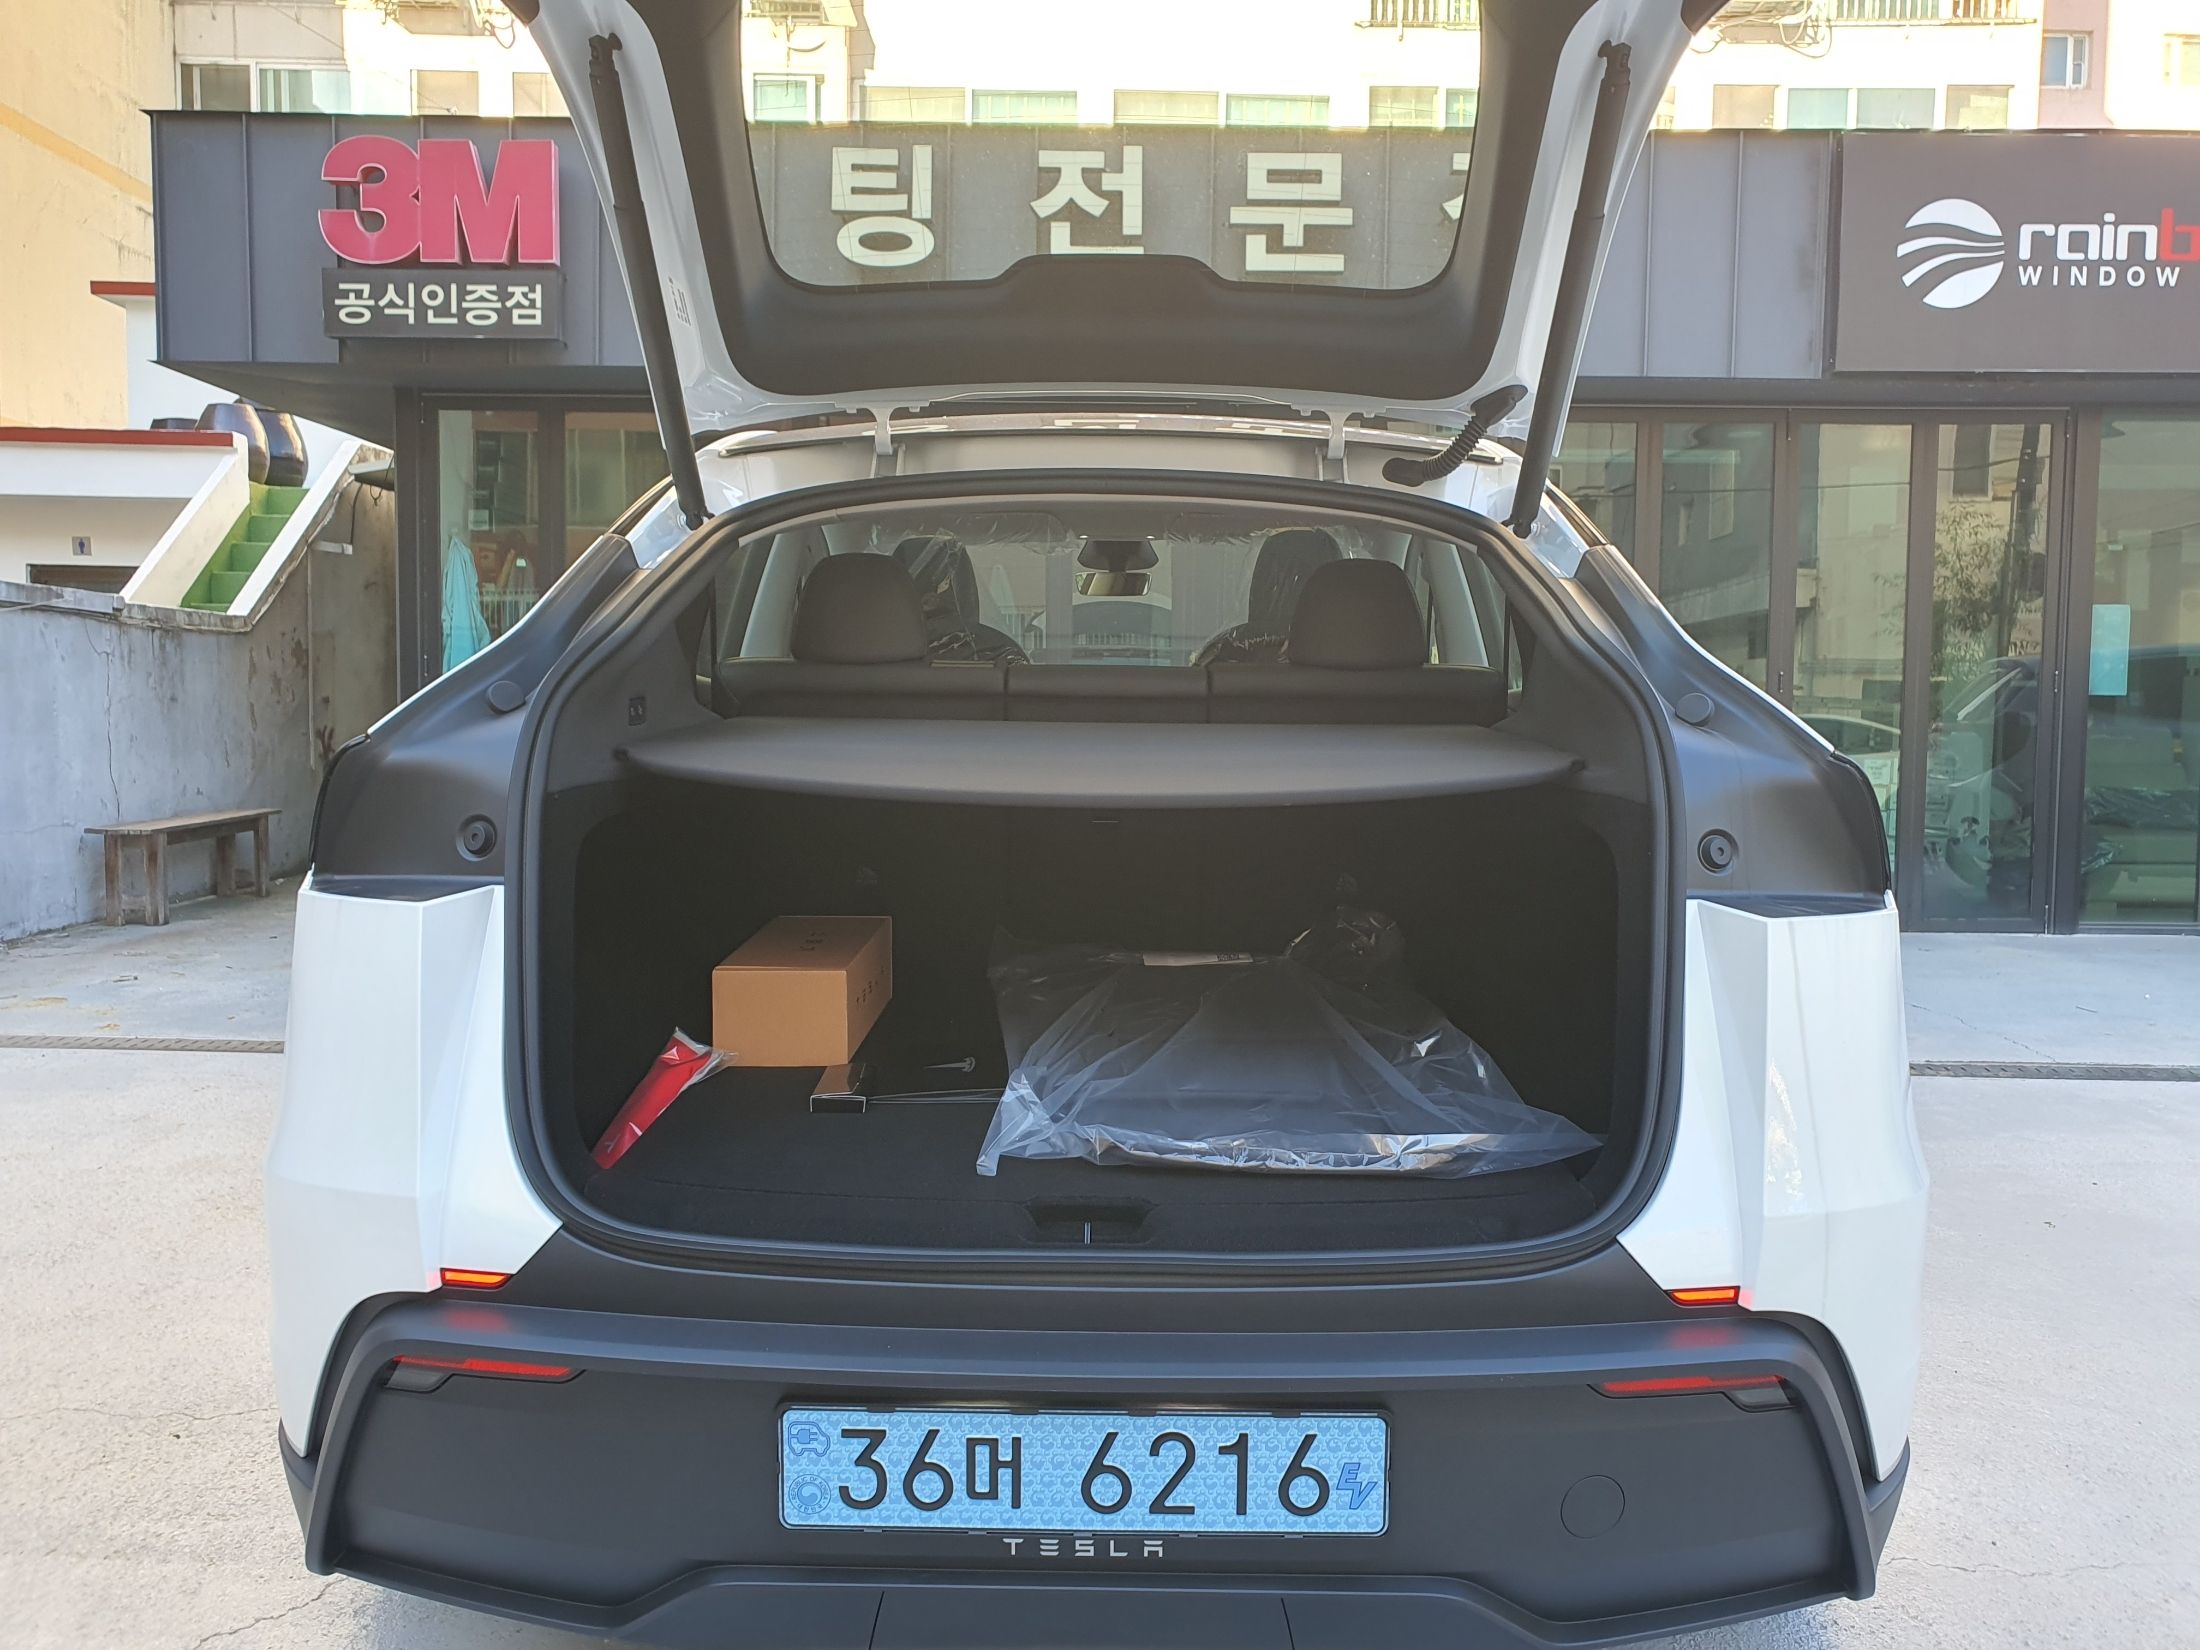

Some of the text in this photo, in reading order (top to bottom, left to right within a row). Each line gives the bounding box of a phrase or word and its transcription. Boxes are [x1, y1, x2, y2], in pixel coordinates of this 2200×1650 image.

[318, 134, 558, 265] 3M
[2018, 265, 2180, 287] WINDOW
[334, 282, 542, 326] 공식인증점
[838, 1428, 1331, 1517] 36머 6216
[1336, 1462, 1378, 1510] EV
[1003, 1538, 1163, 1557] TESLA
